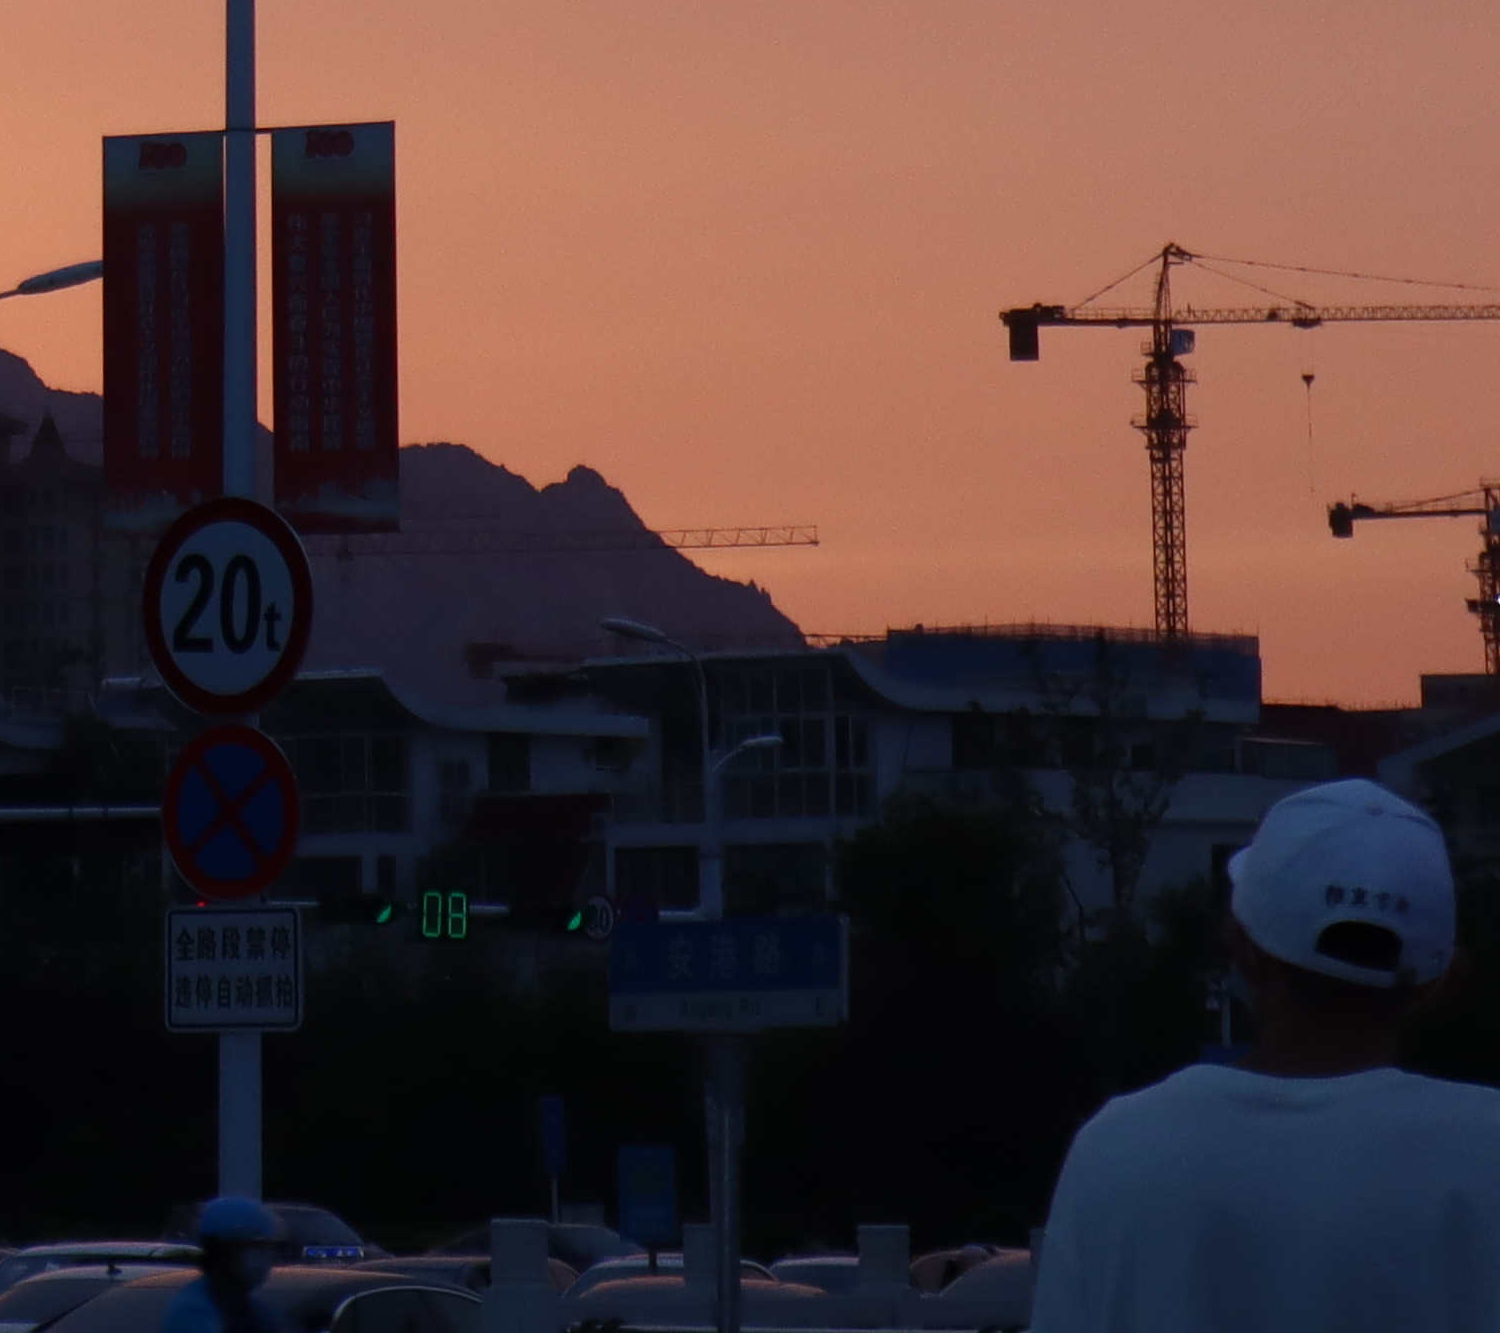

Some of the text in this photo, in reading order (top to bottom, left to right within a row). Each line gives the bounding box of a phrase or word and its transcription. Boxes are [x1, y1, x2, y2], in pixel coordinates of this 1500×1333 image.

[173, 553, 282, 654] 20t
[422, 891, 468, 939] 08
[175, 926, 291, 961] 全路段禁停
[666, 931, 782, 980] 安港路
[811, 940, 828, 966] 东
[175, 974, 293, 1010] 违停自动抓拍
[622, 997, 827, 1022] W Angang Rd E
